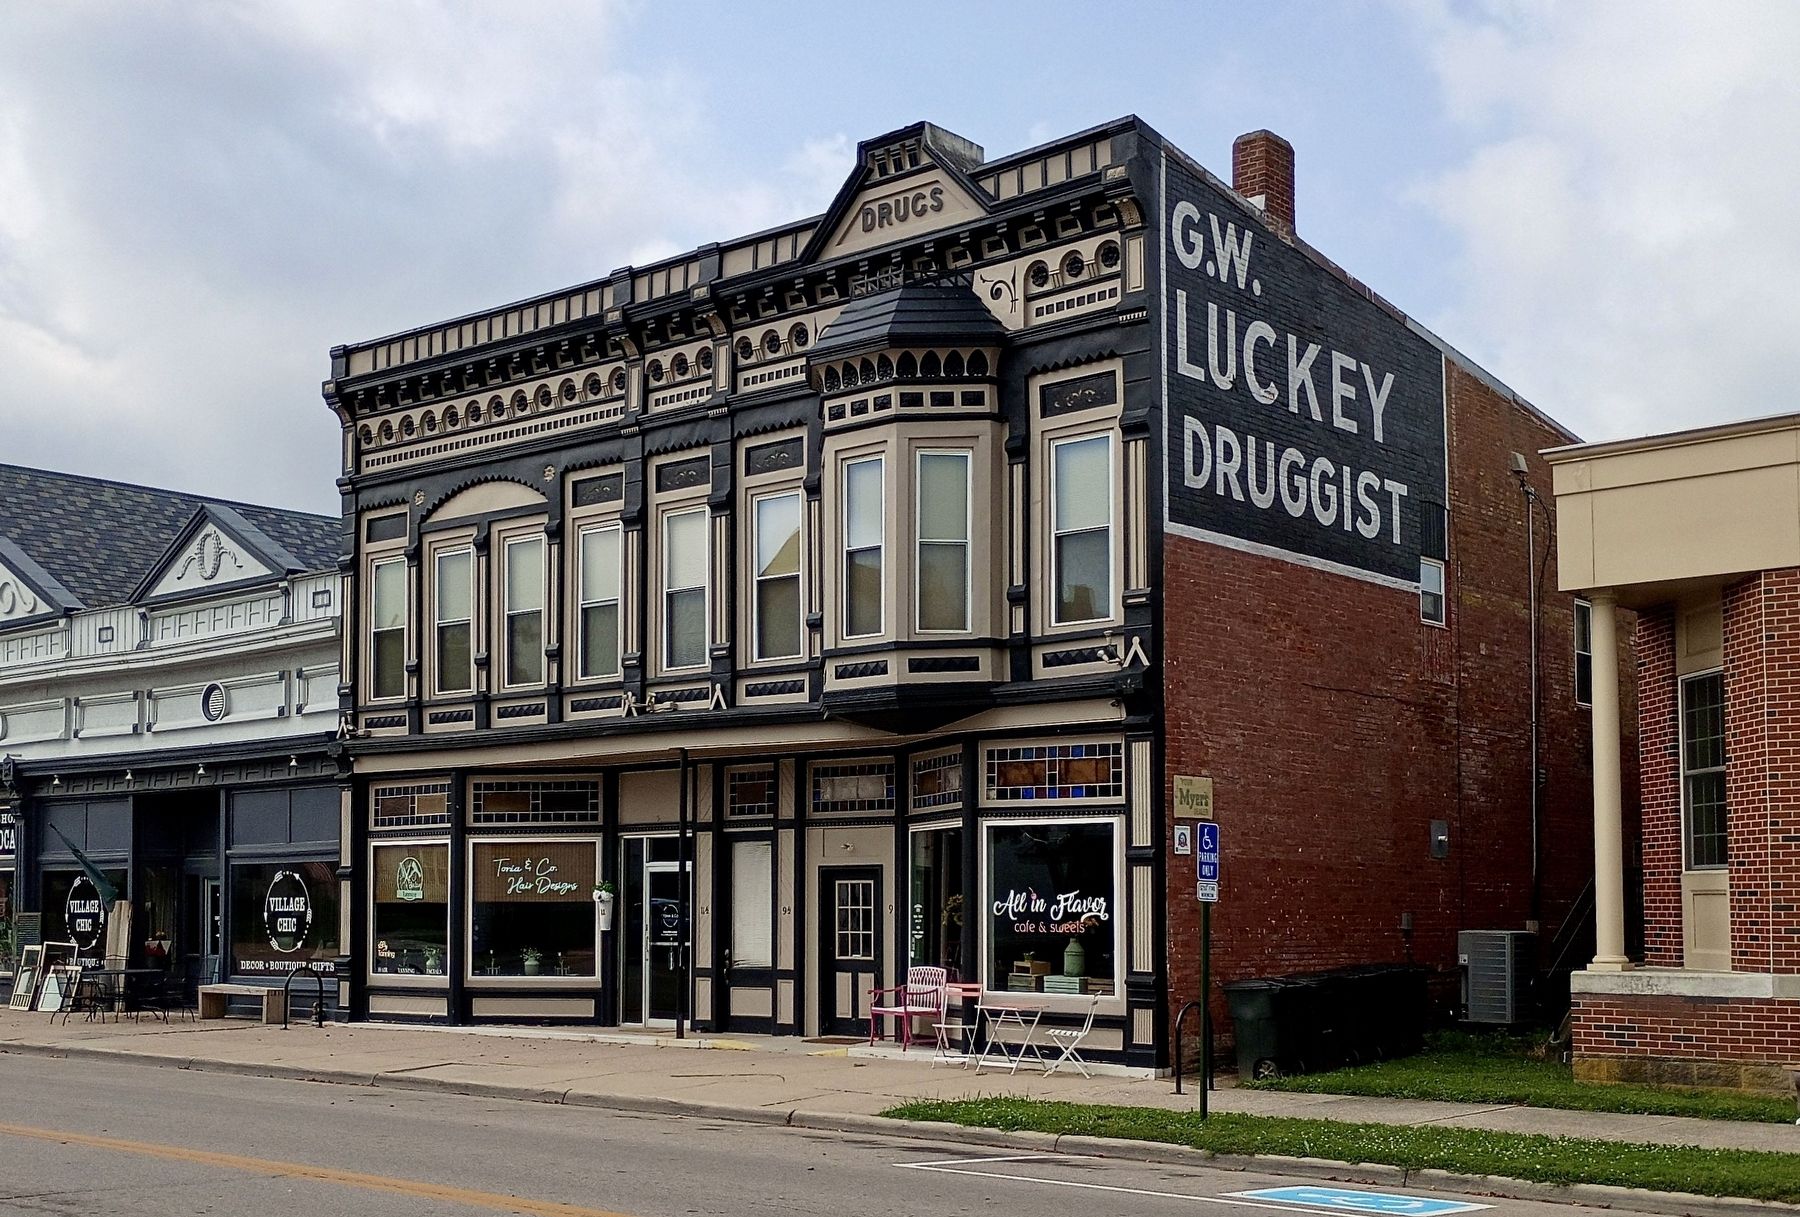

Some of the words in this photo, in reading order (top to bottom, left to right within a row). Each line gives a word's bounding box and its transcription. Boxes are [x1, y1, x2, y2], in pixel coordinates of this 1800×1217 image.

[862, 187, 944, 233] DRUGS
[1171, 200, 1262, 297] G.W.
[1176, 289, 1395, 443] LUCKEY
[1183, 414, 1408, 545] DRUGGIST
[1, 813, 16, 824] HO
[1199, 851, 1217, 863] PARKING
[524, 857, 532, 872] &
[536, 857, 558, 876] Co.
[1202, 864, 1214, 876] ONLY
[507, 876, 535, 895] Hair
[535, 876, 578, 896] Designs
[69, 900, 99, 913] VILLAGE
[269, 897, 306, 912] VILLAGE
[888, 904, 894, 914] 9
[993, 889, 1028, 921] All
[1029, 886, 1047, 913] in
[1050, 889, 1109, 923] Flavor
[75, 918, 92, 932] CHIC
[277, 917, 297, 932] CHIC
[1014, 919, 1036, 933] cafe
[1038, 921, 1047, 933] &
[1049, 920, 1086, 934] sweets
[240, 960, 265, 970] DECOR
[312, 962, 335, 972] GIFTS
